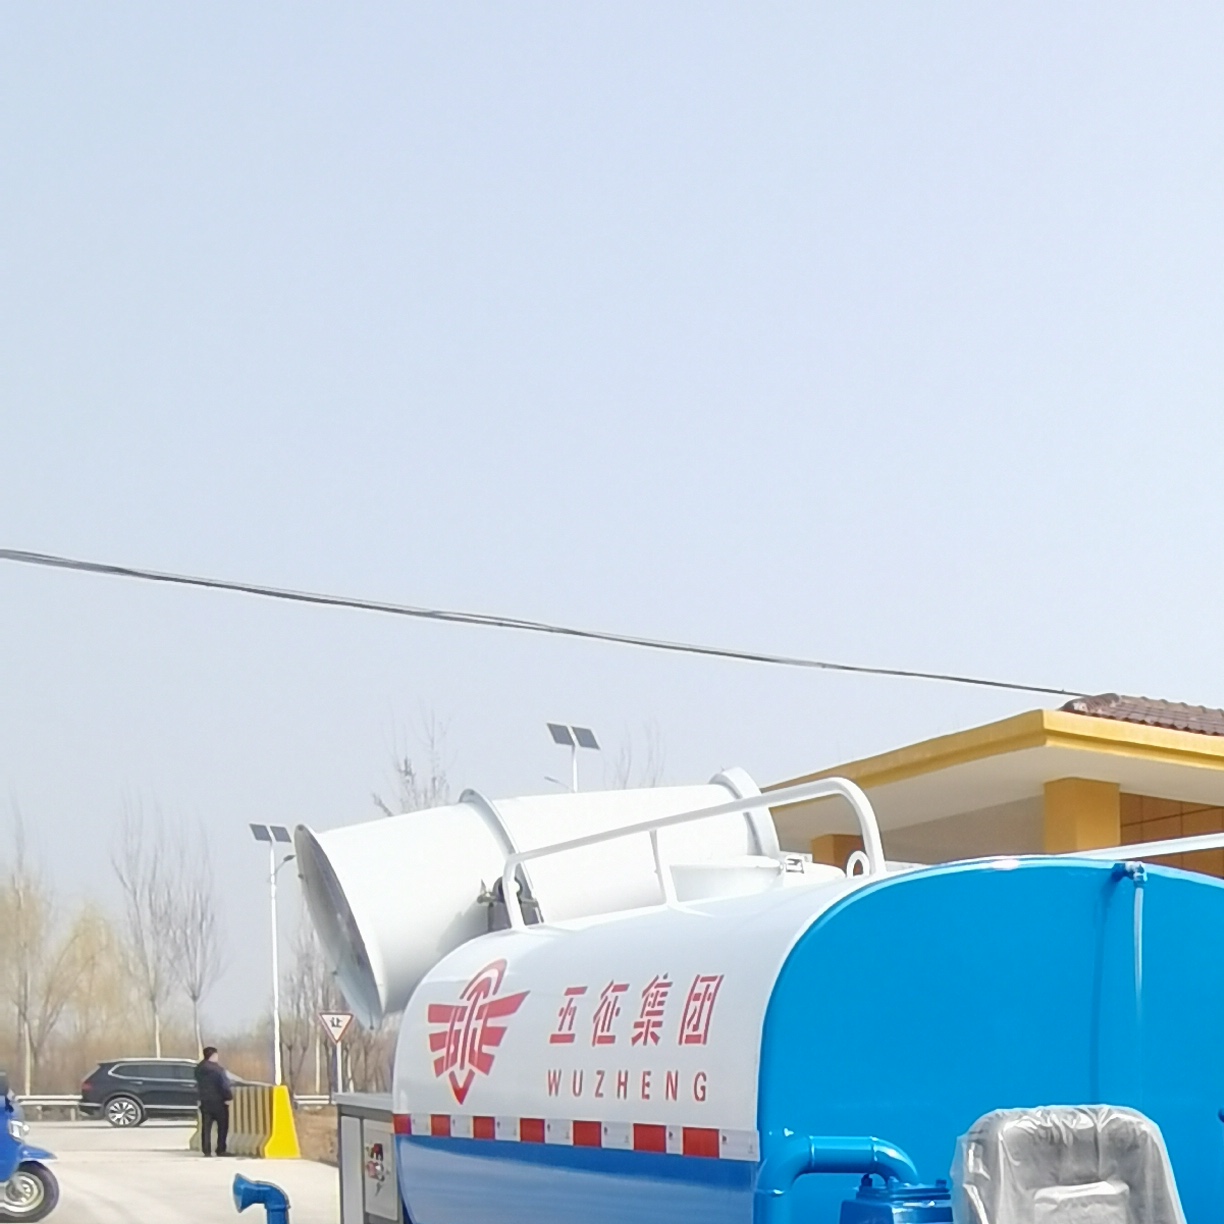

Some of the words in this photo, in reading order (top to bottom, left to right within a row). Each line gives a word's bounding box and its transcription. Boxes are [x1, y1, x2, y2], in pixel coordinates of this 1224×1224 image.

[330, 1016, 343, 1028] 让
[549, 973, 725, 1047] 五征集团
[547, 1068, 708, 1102] WUZHENG
